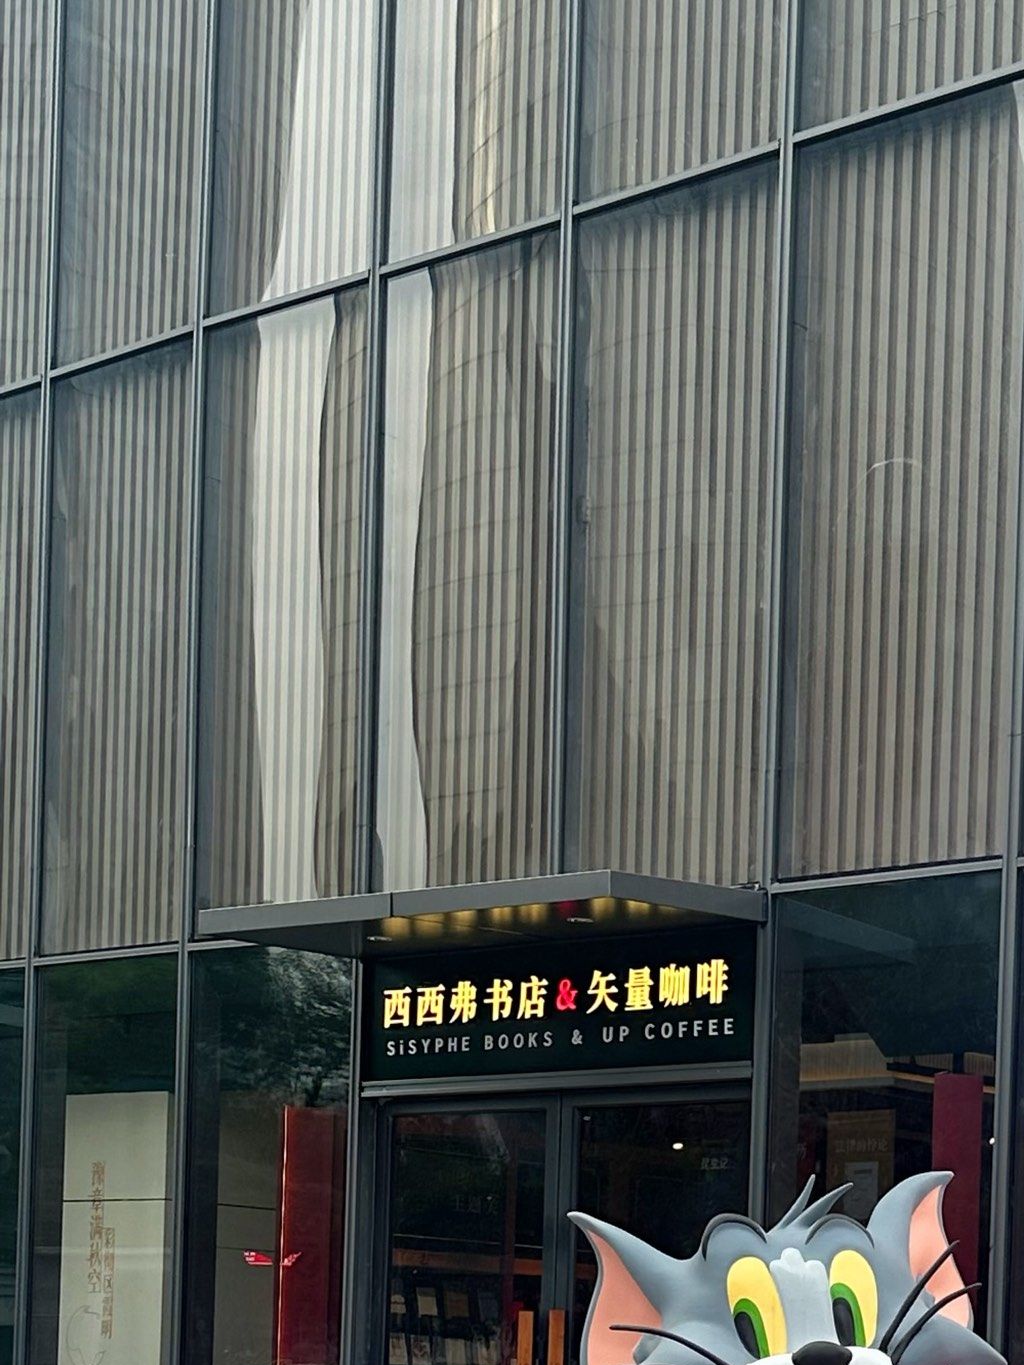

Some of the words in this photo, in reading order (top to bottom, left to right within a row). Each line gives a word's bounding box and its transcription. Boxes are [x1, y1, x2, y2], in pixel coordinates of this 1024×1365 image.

[484, 1031, 553, 1051] BOOKS
[571, 1029, 583, 1045] &
[602, 1025, 630, 1043] UP
[644, 1018, 735, 1040] COFFEE
